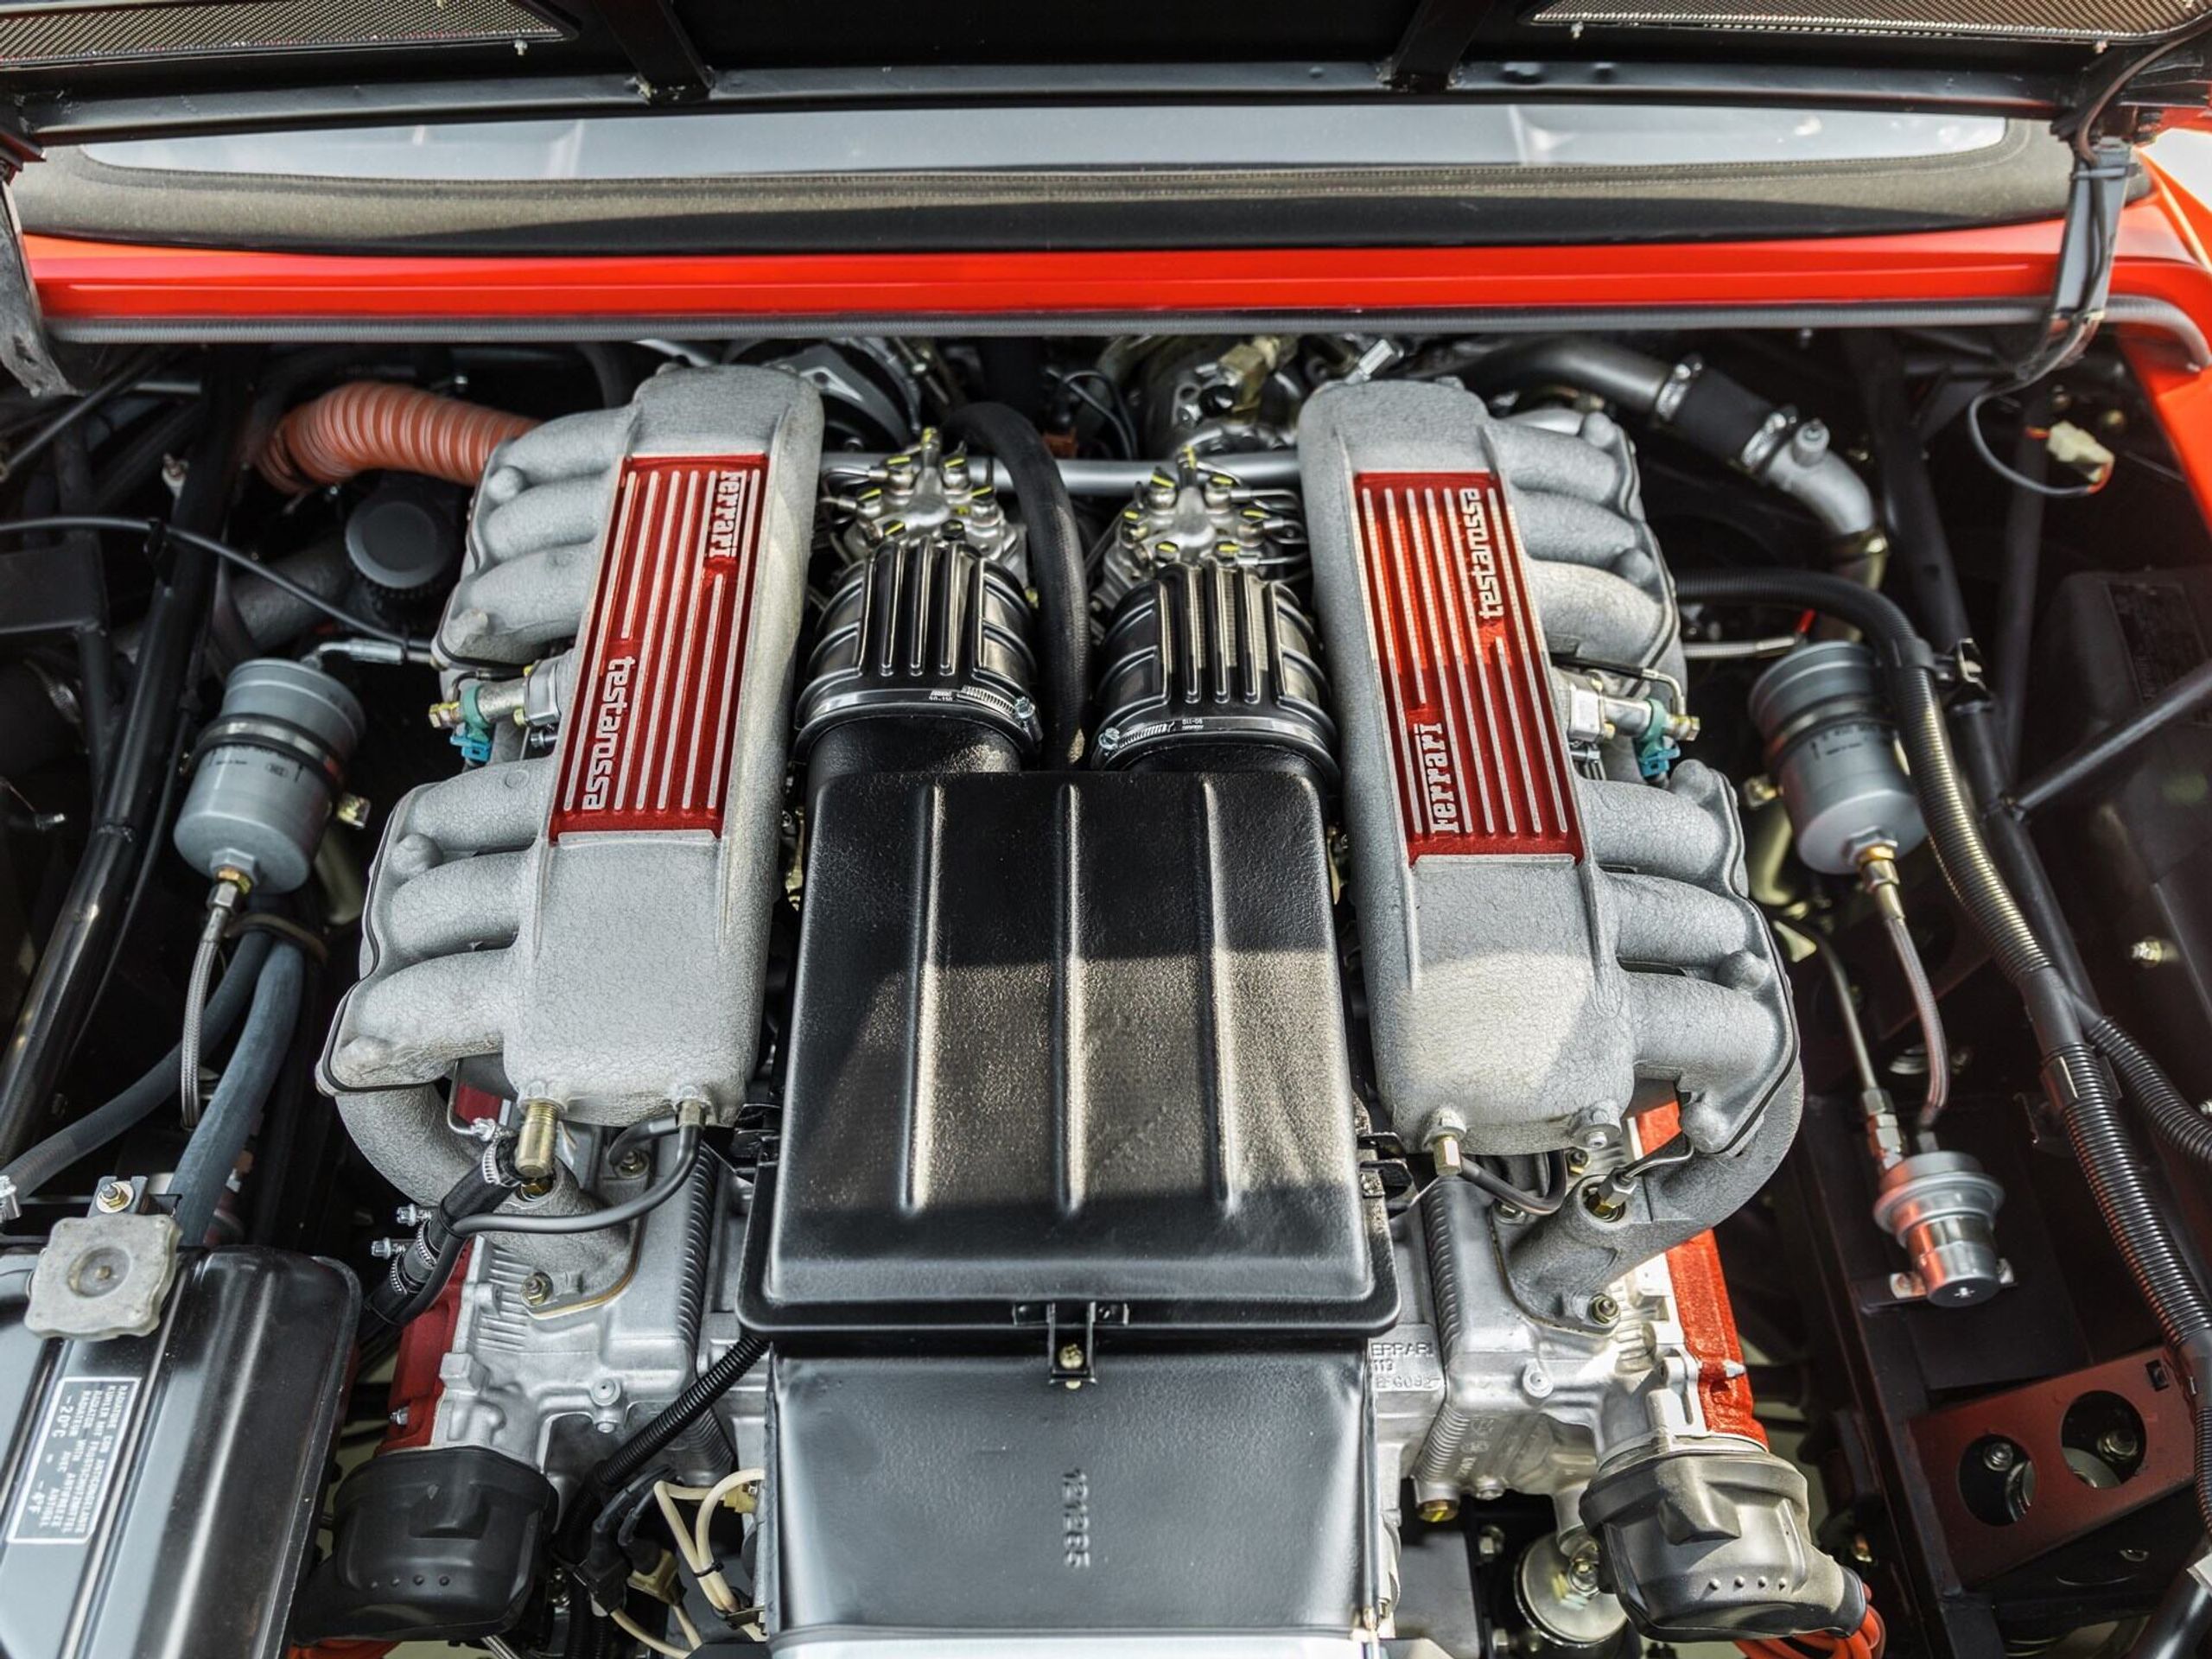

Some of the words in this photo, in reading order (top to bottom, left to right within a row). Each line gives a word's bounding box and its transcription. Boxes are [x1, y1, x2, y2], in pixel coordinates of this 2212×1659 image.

[709, 470, 747, 559] Ferrari
[1459, 486, 1504, 617] testarossa
[582, 656, 634, 810] testarossa
[1414, 722, 1460, 833] Ferrari
[1371, 1342, 1433, 1356] ERRARI
